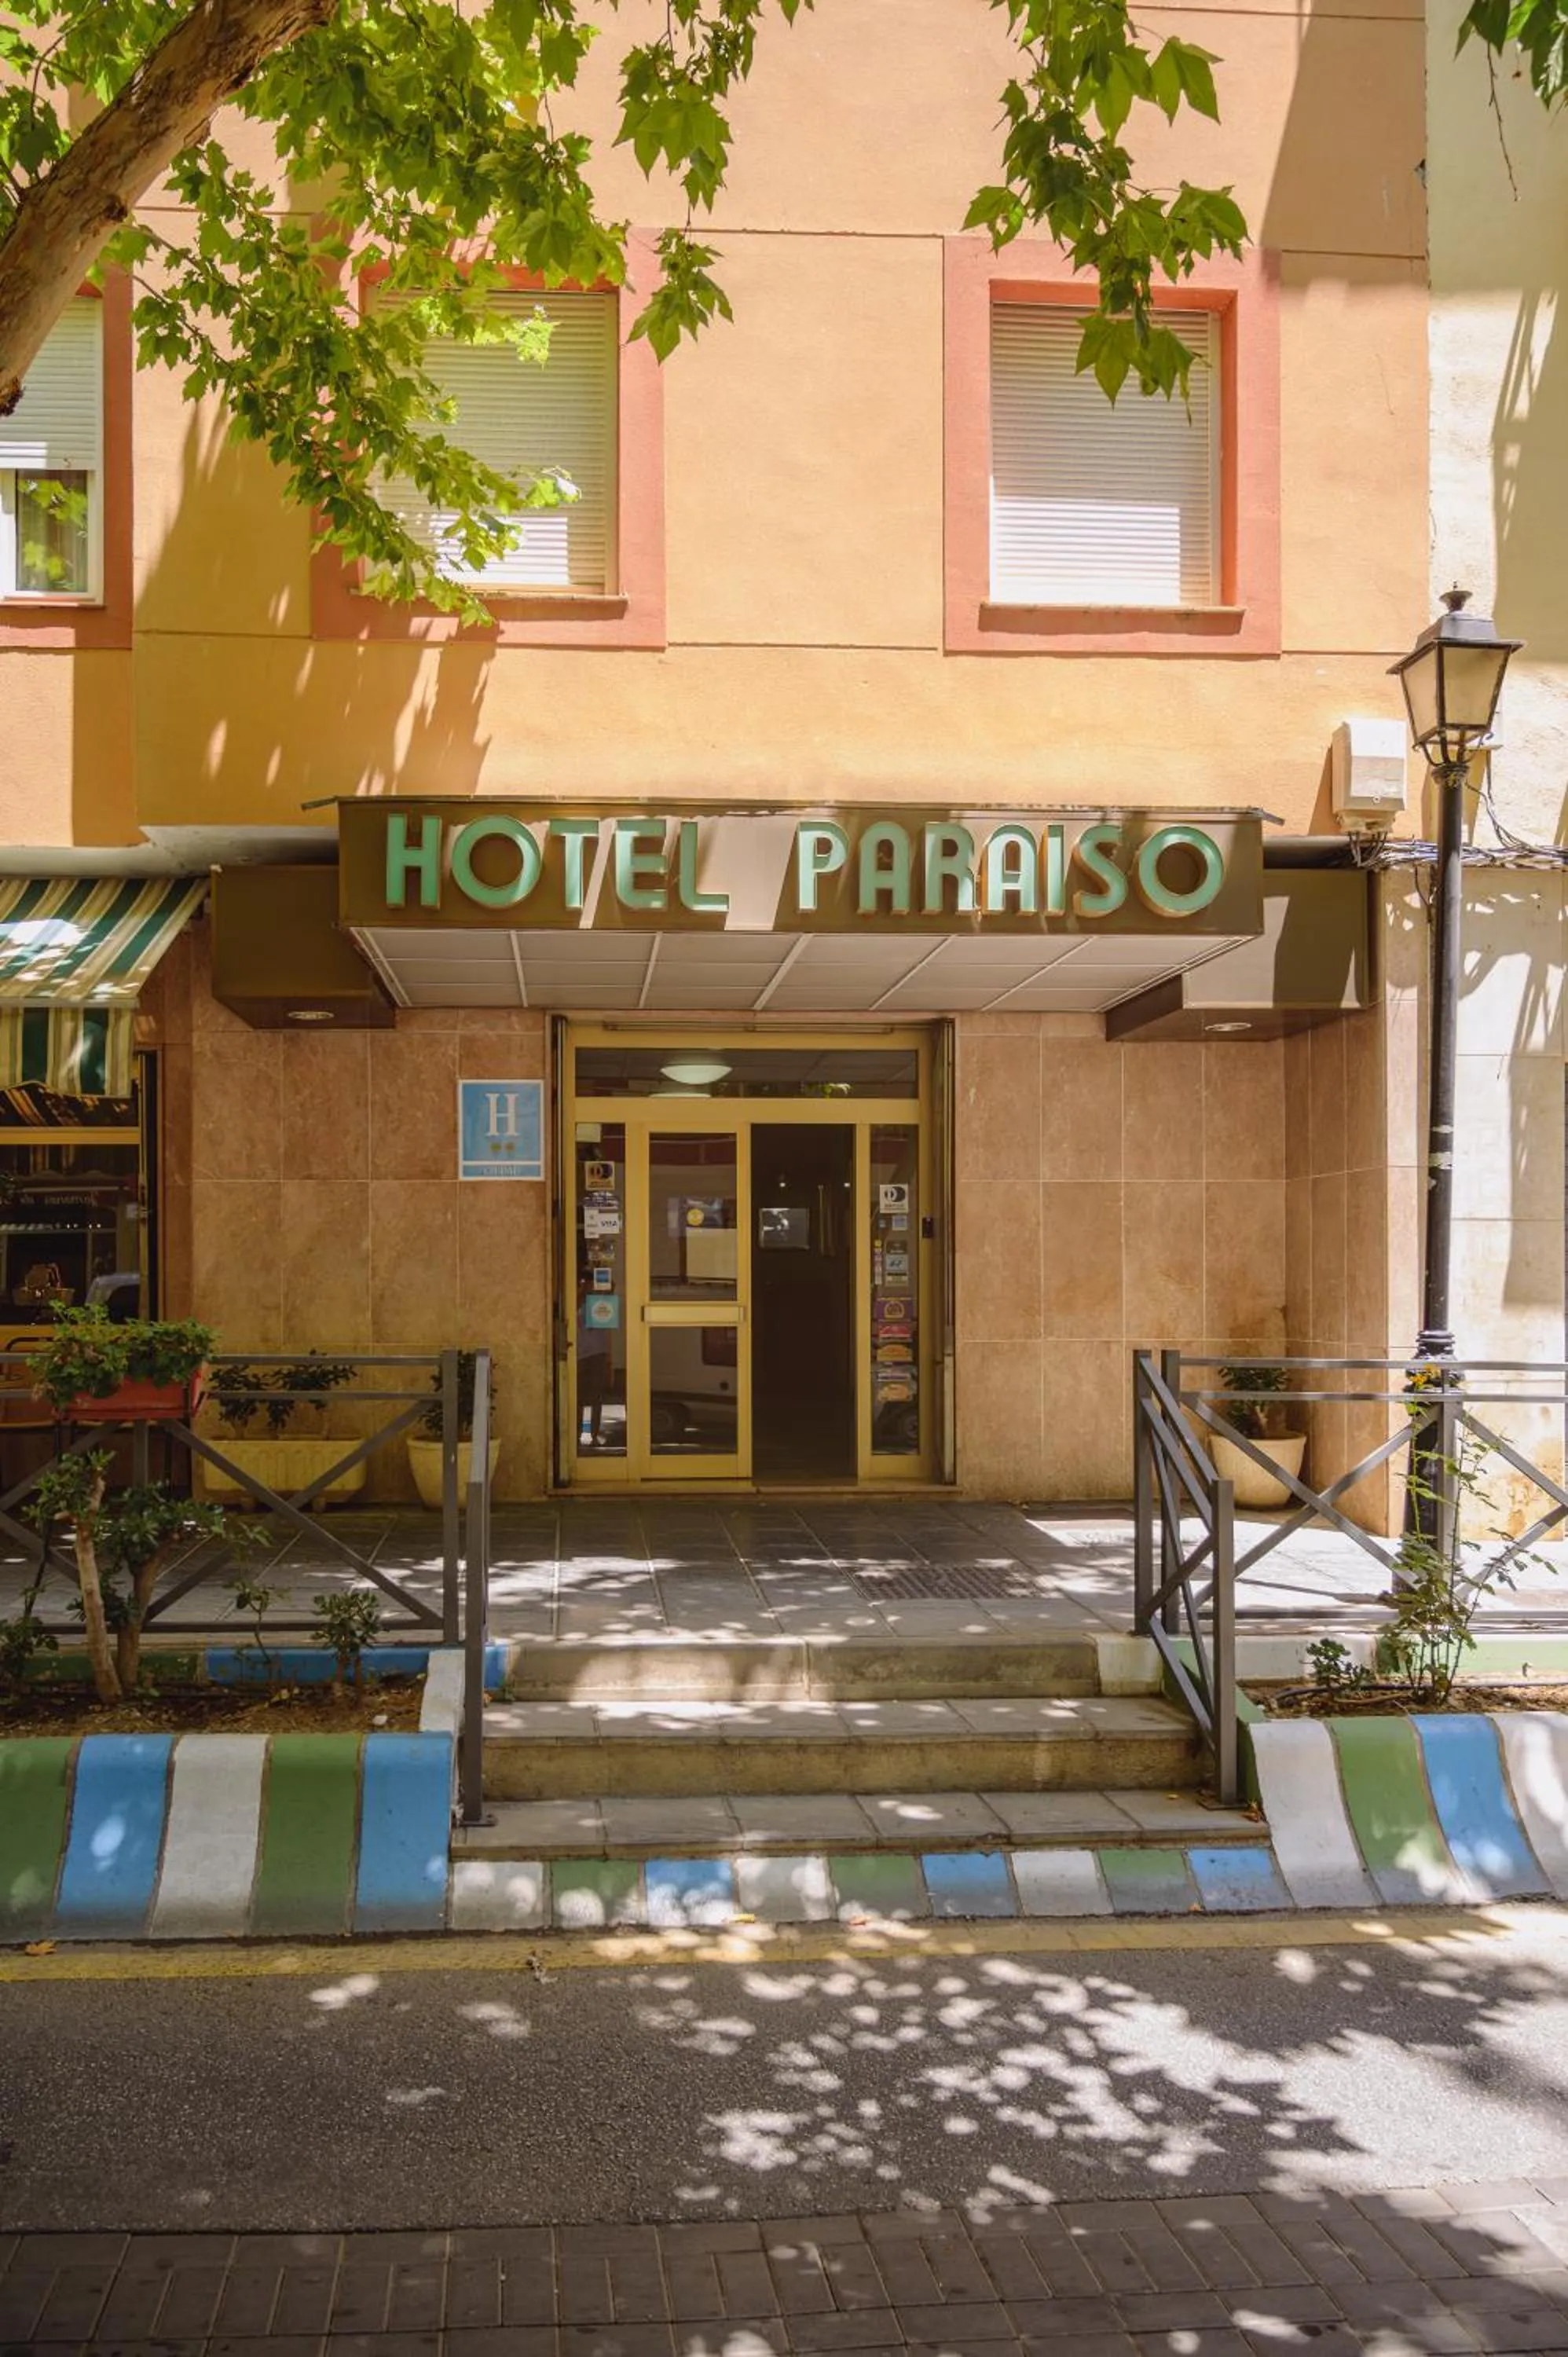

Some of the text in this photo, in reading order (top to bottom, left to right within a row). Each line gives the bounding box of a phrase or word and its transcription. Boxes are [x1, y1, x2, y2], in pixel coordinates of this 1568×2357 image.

[385, 815, 1225, 918] HOTEL PARAISO
[485, 1093, 519, 1136] H
